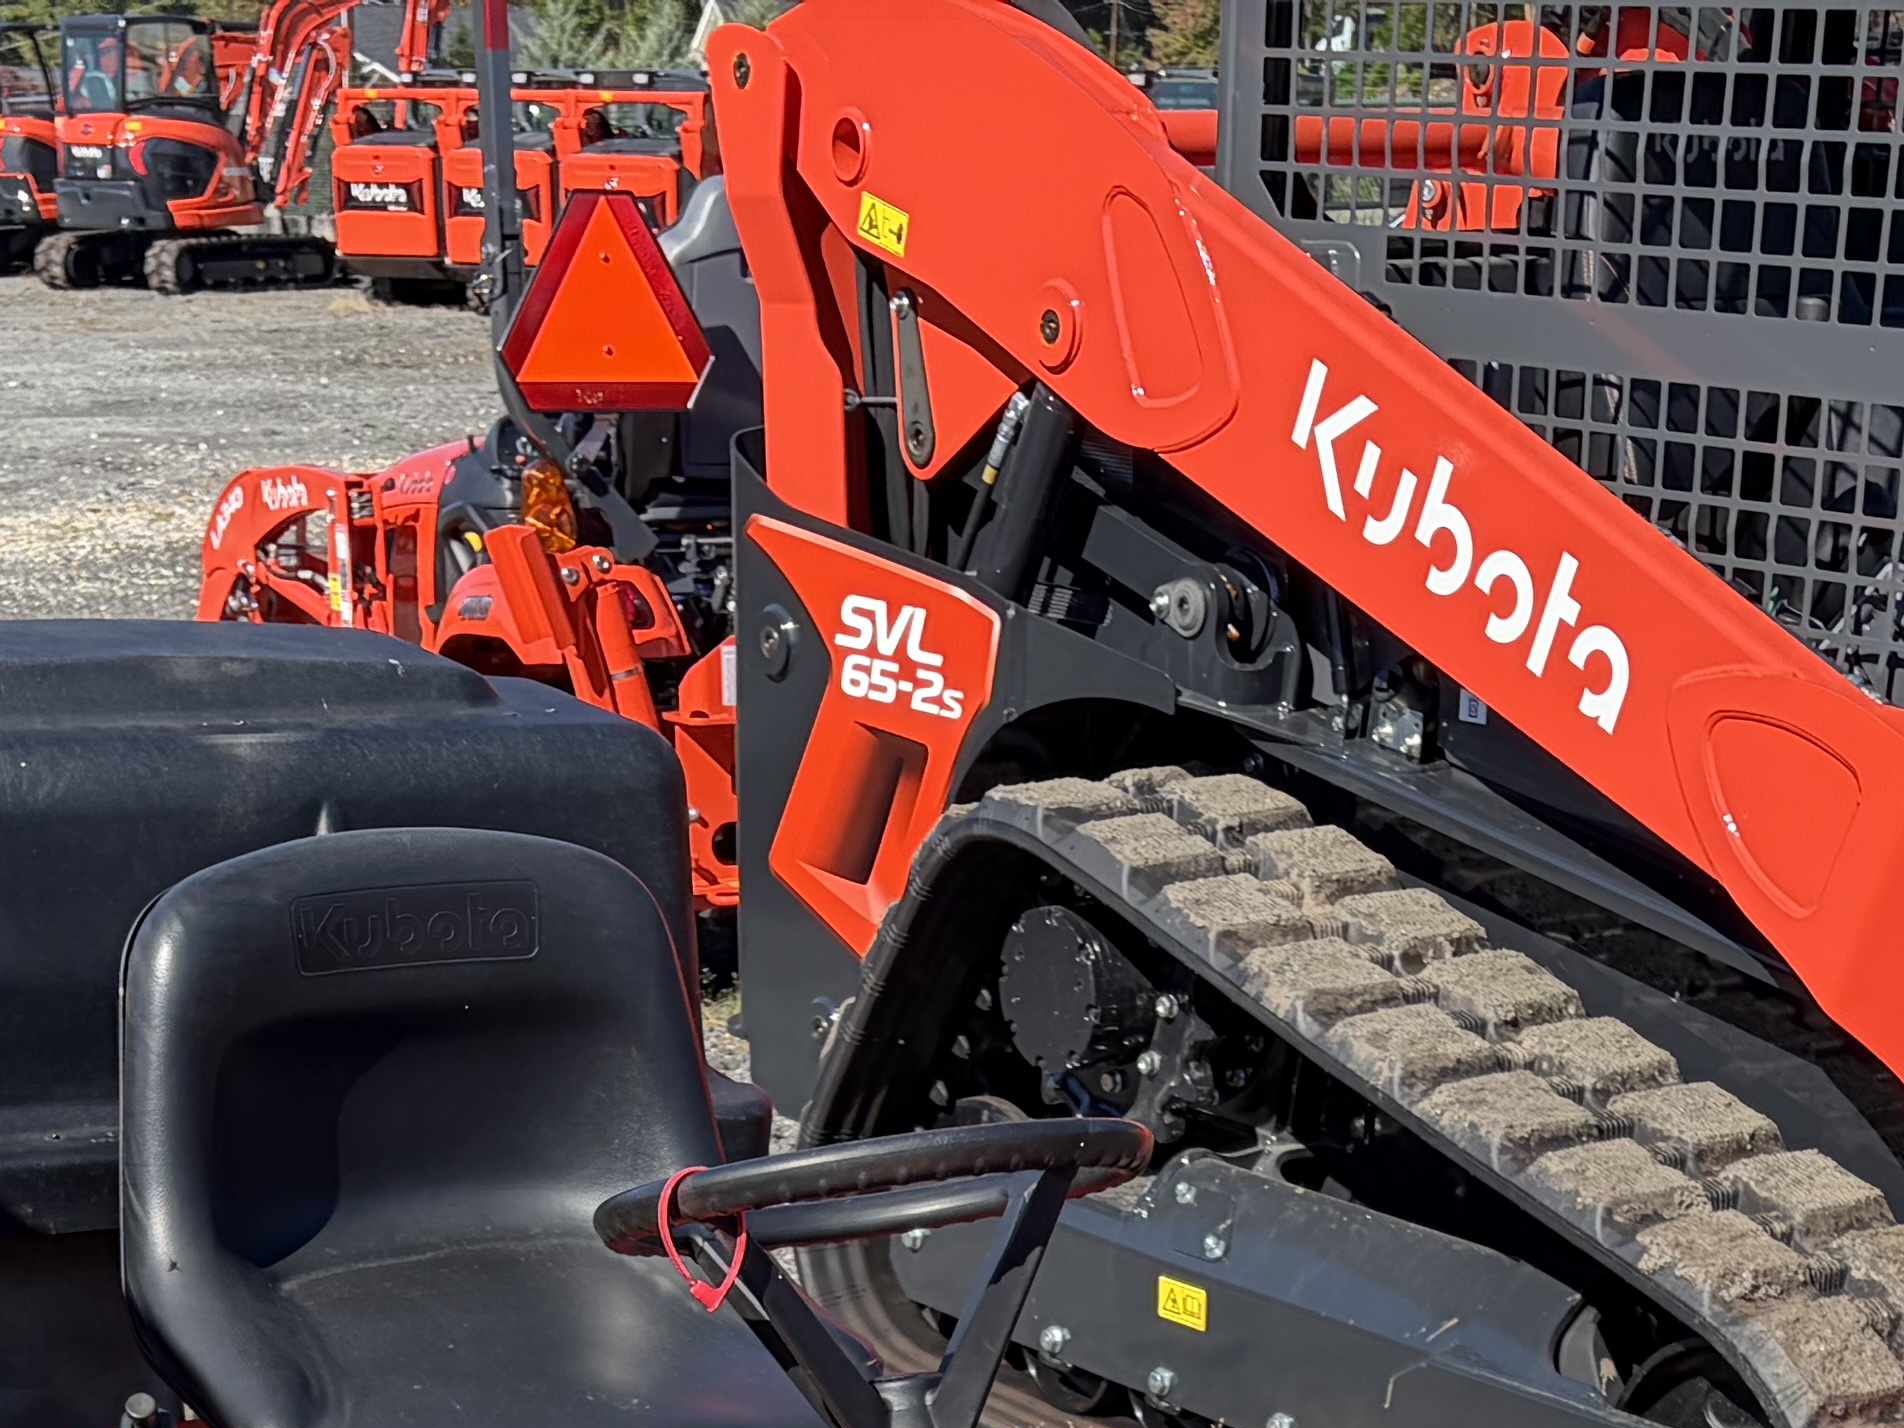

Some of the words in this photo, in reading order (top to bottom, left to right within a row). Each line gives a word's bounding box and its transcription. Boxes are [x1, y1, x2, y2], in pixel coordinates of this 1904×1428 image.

[1290, 357, 1633, 737] Kubota
[834, 594, 945, 667] SVL
[299, 891, 532, 963] Kubota
